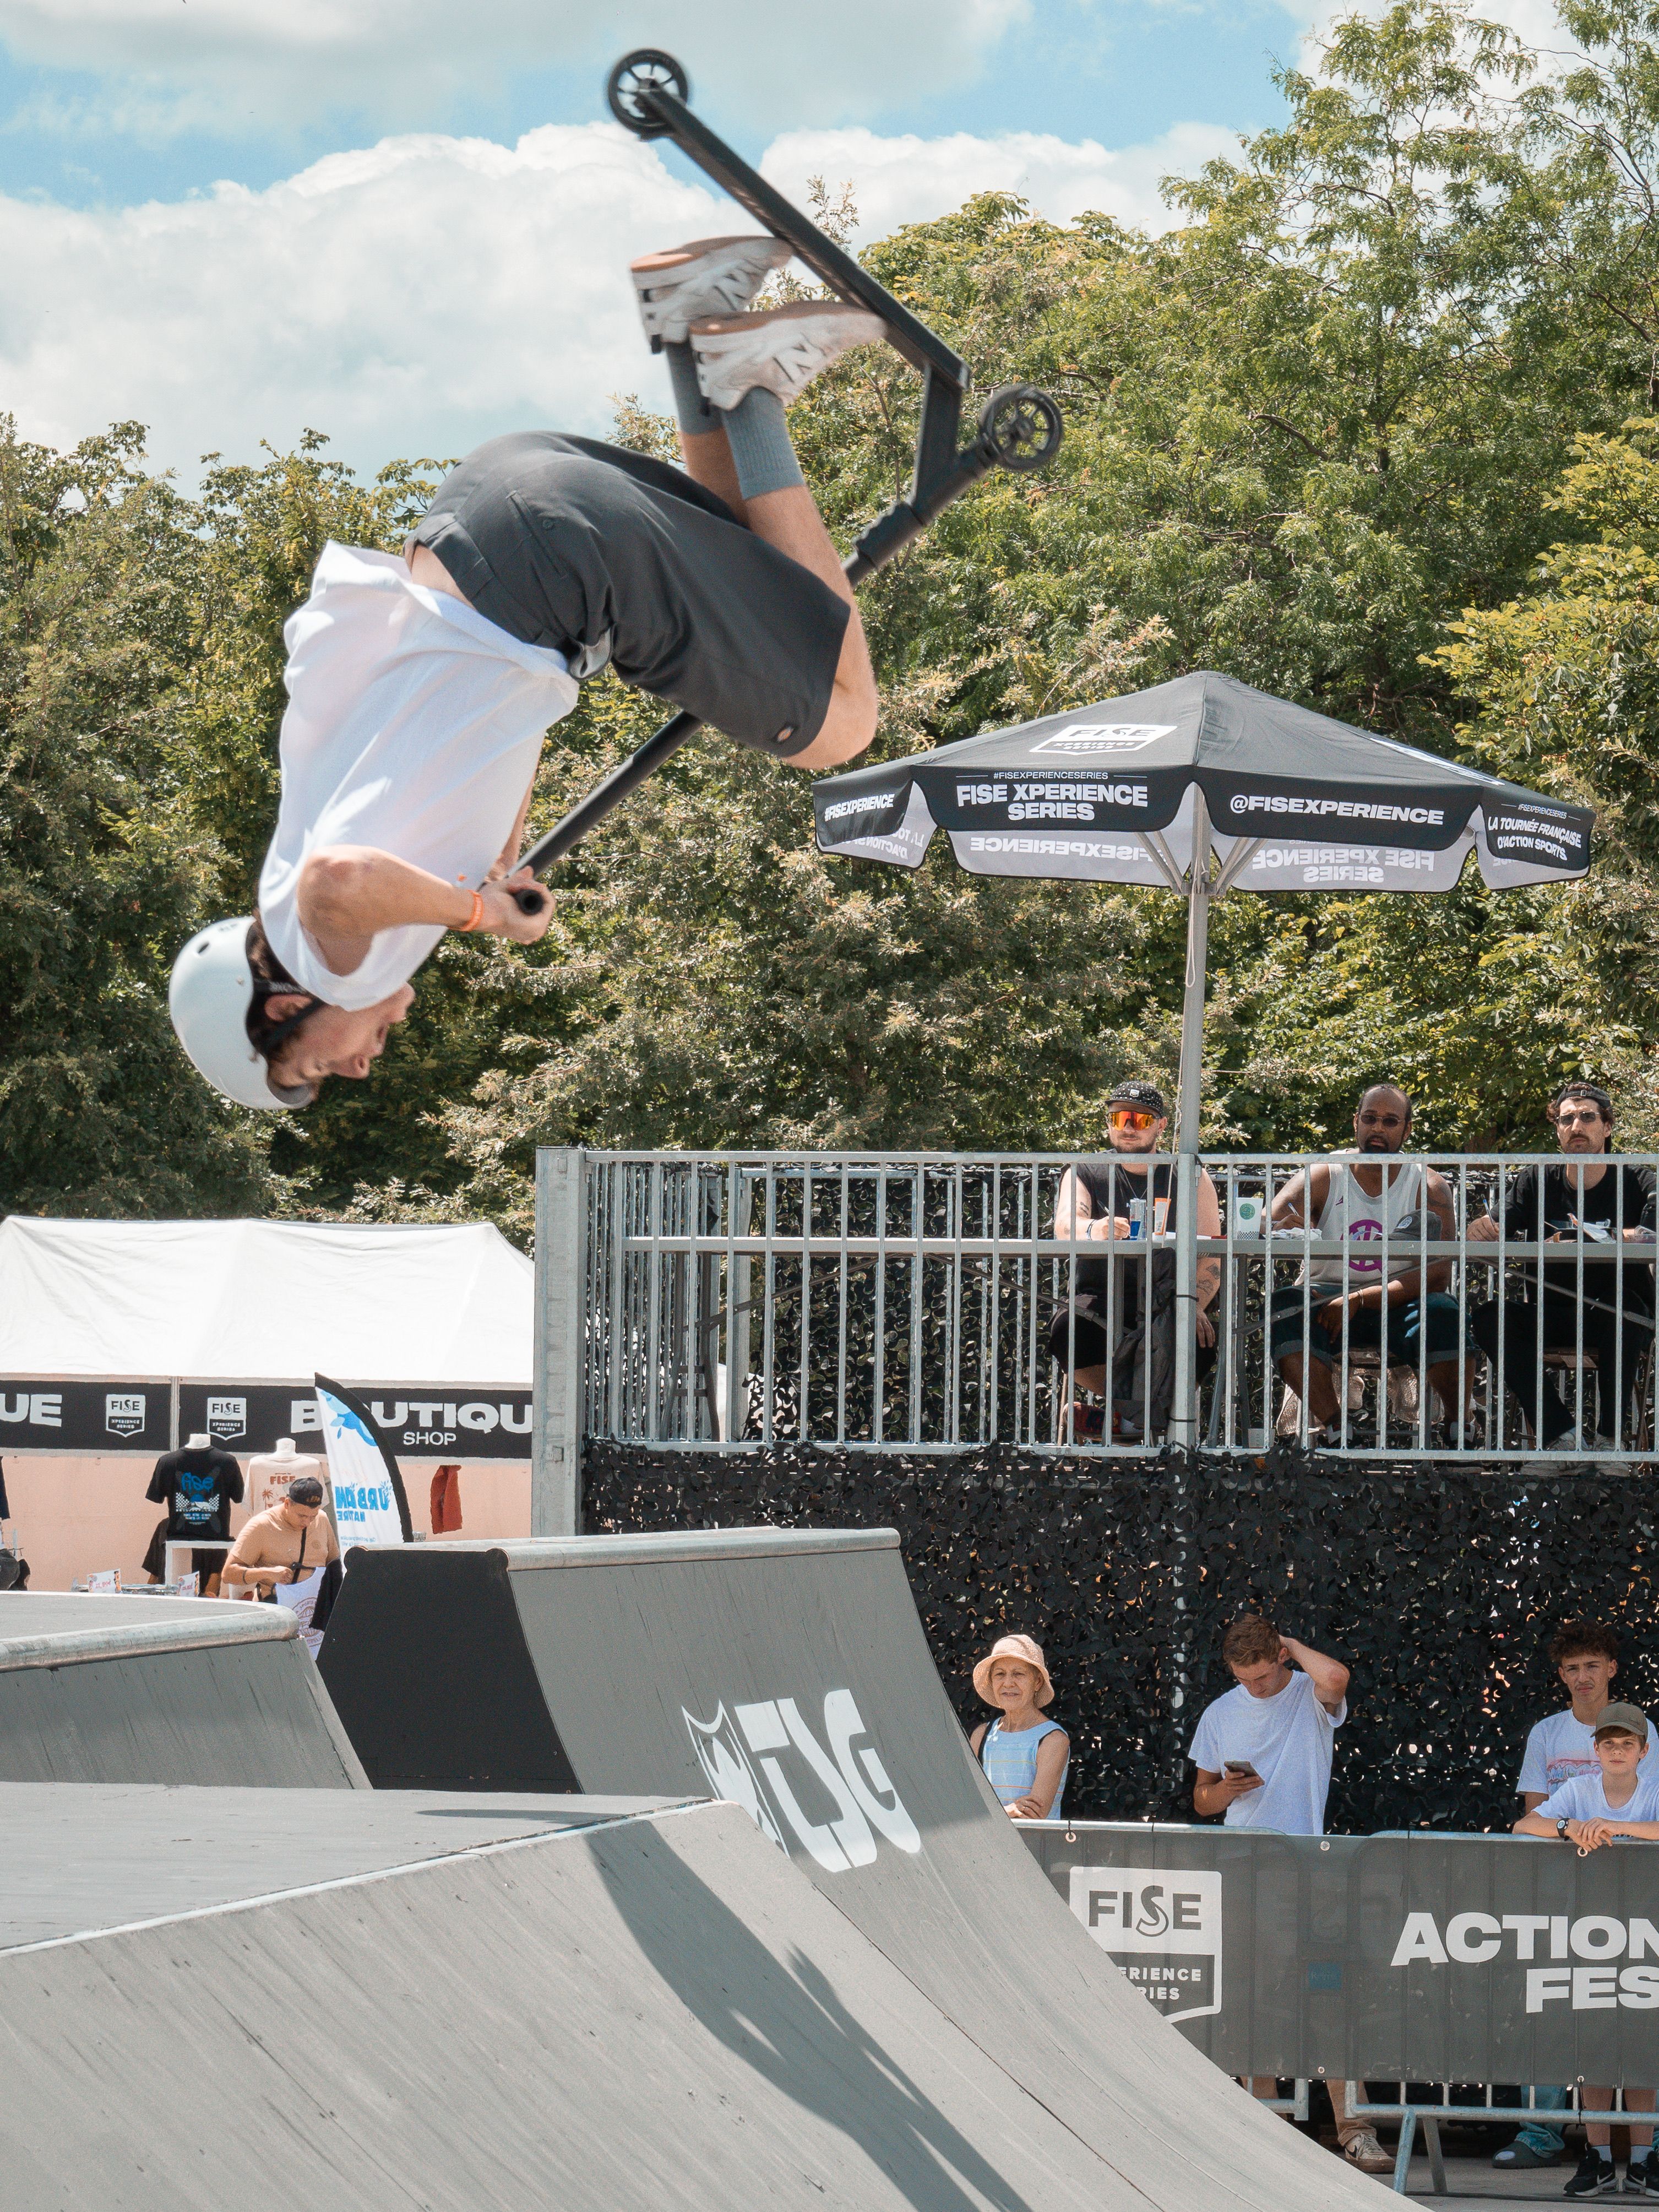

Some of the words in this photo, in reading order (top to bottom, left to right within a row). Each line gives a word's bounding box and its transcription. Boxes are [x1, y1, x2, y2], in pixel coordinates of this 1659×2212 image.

[1069, 728, 1156, 737] FISE
[993, 771, 1108, 780] #FISEXPERIENCESERIES
[956, 784, 1008, 807] FISE
[1013, 784, 1148, 807] XPERIENCE
[825, 794, 895, 822] #FISEXPERIENCE
[1008, 802, 1095, 821] SERIES
[1230, 795, 1444, 825] @FISEXPERIENCE
[1488, 817, 1498, 830] LA
[1500, 818, 1540, 833] TOURNÉE
[1538, 823, 1582, 849] FRANÇAISE
[1498, 835, 1535, 849] D'ACTION
[1535, 839, 1568, 861] SPORTS
[0, 1393, 62, 1427] UE
[111, 1399, 140, 1412] FISE
[212, 1403, 241, 1415] FISE
[291, 1400, 532, 1434] BUTIQU
[403, 1432, 456, 1445] SHOP
[1089, 1885, 1202, 1937] FISE
